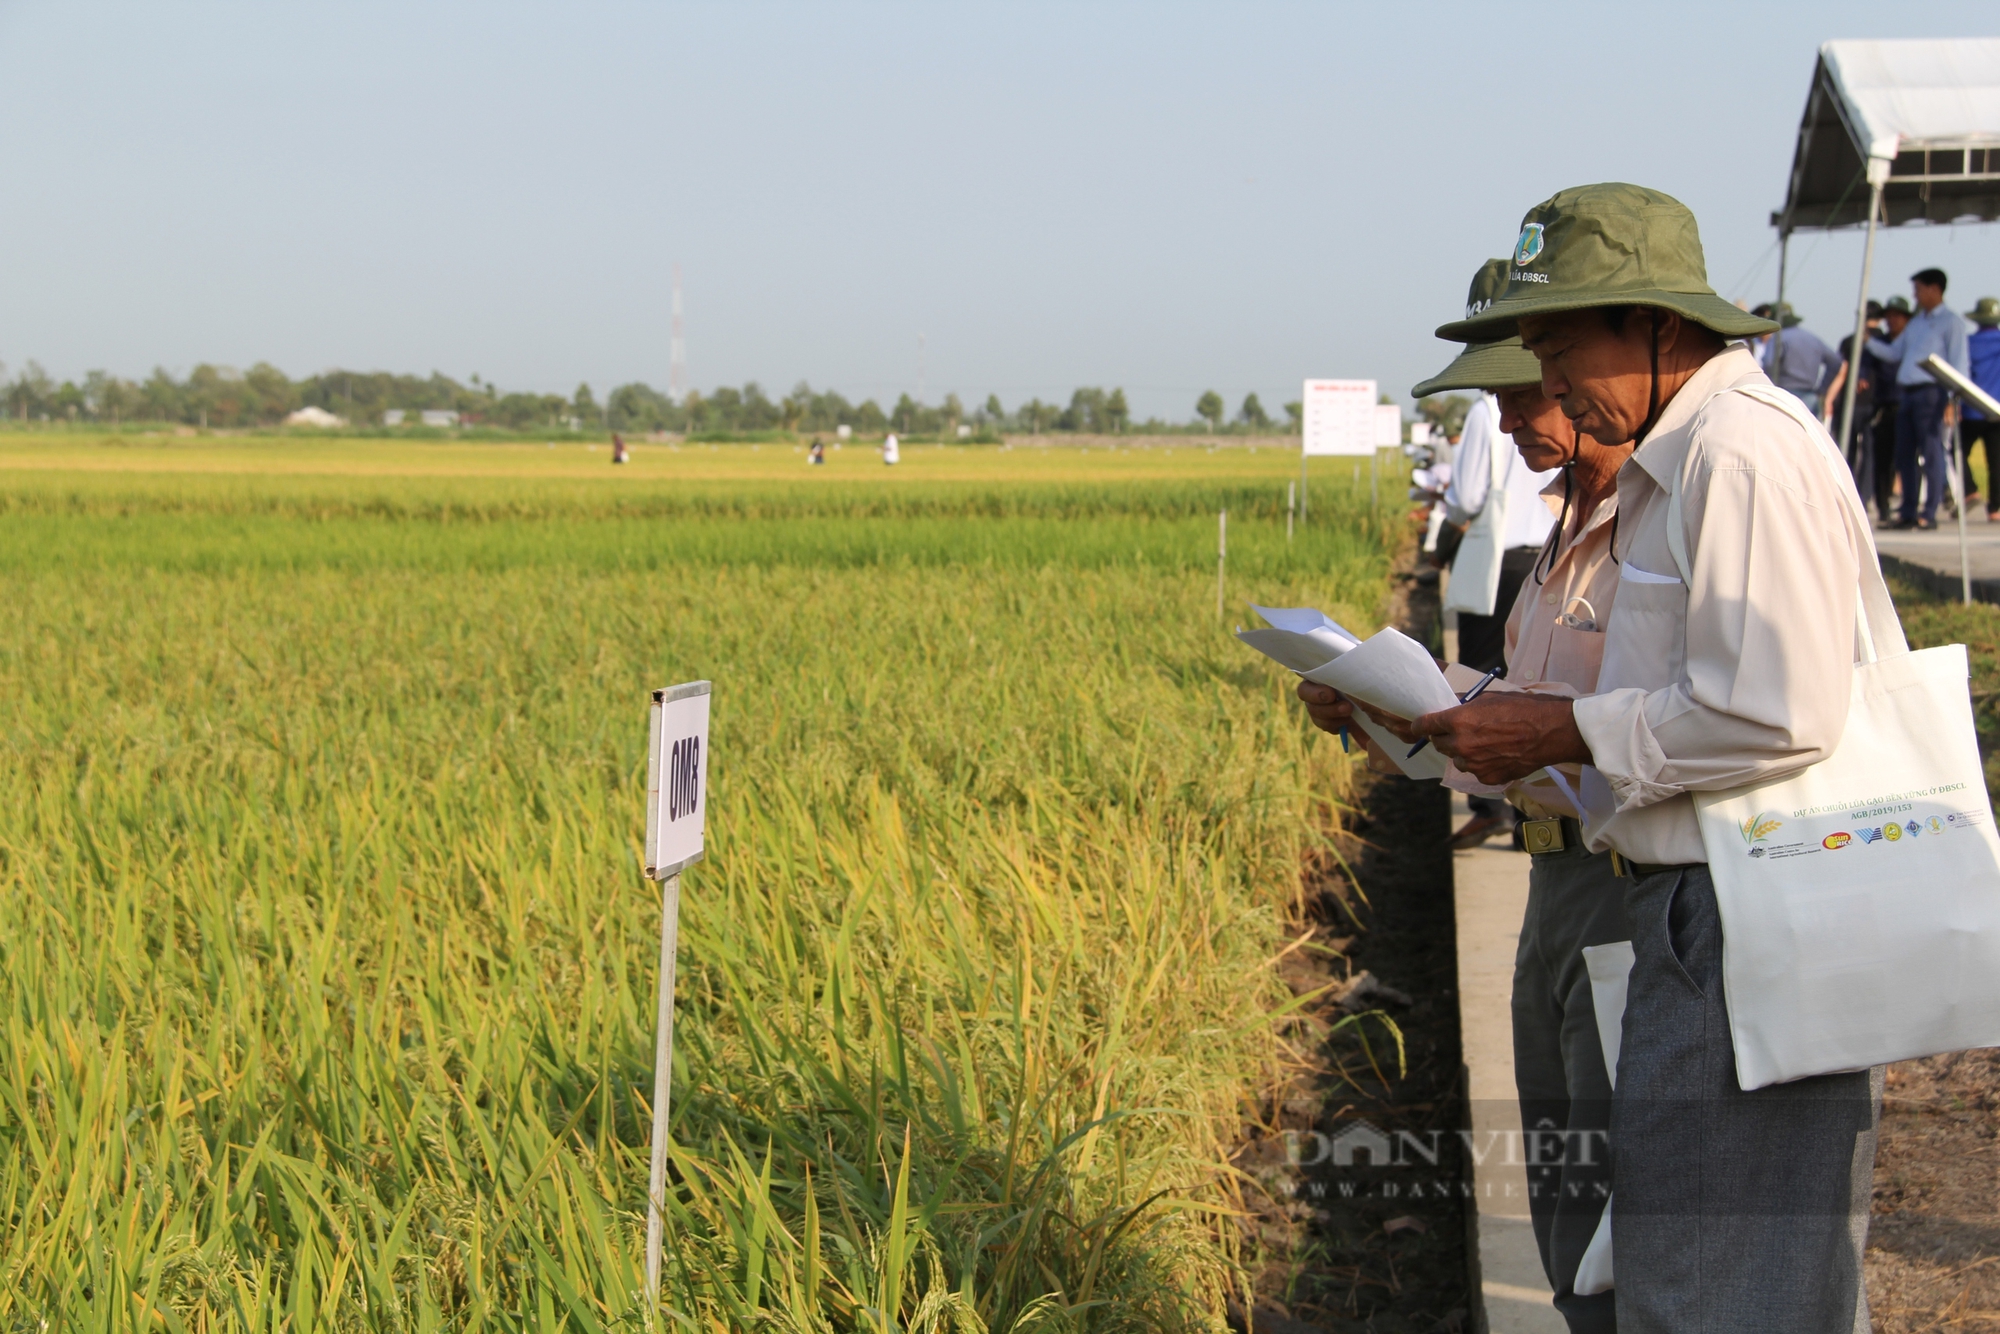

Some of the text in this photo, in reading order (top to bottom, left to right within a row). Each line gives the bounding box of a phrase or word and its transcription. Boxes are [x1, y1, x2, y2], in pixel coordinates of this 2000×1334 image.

[1522, 272, 1550, 284] ĐBSCL
[669, 735, 700, 823] OM8
[1793, 809, 1807, 818] DỰ
[1809, 806, 1821, 815] ÁN
[1849, 798, 1866, 809] LÚA
[1866, 796, 1885, 807] GẠO
[1938, 782, 1967, 794] ĐBSCL
[1851, 803, 1913, 820] AGB/2019/153
